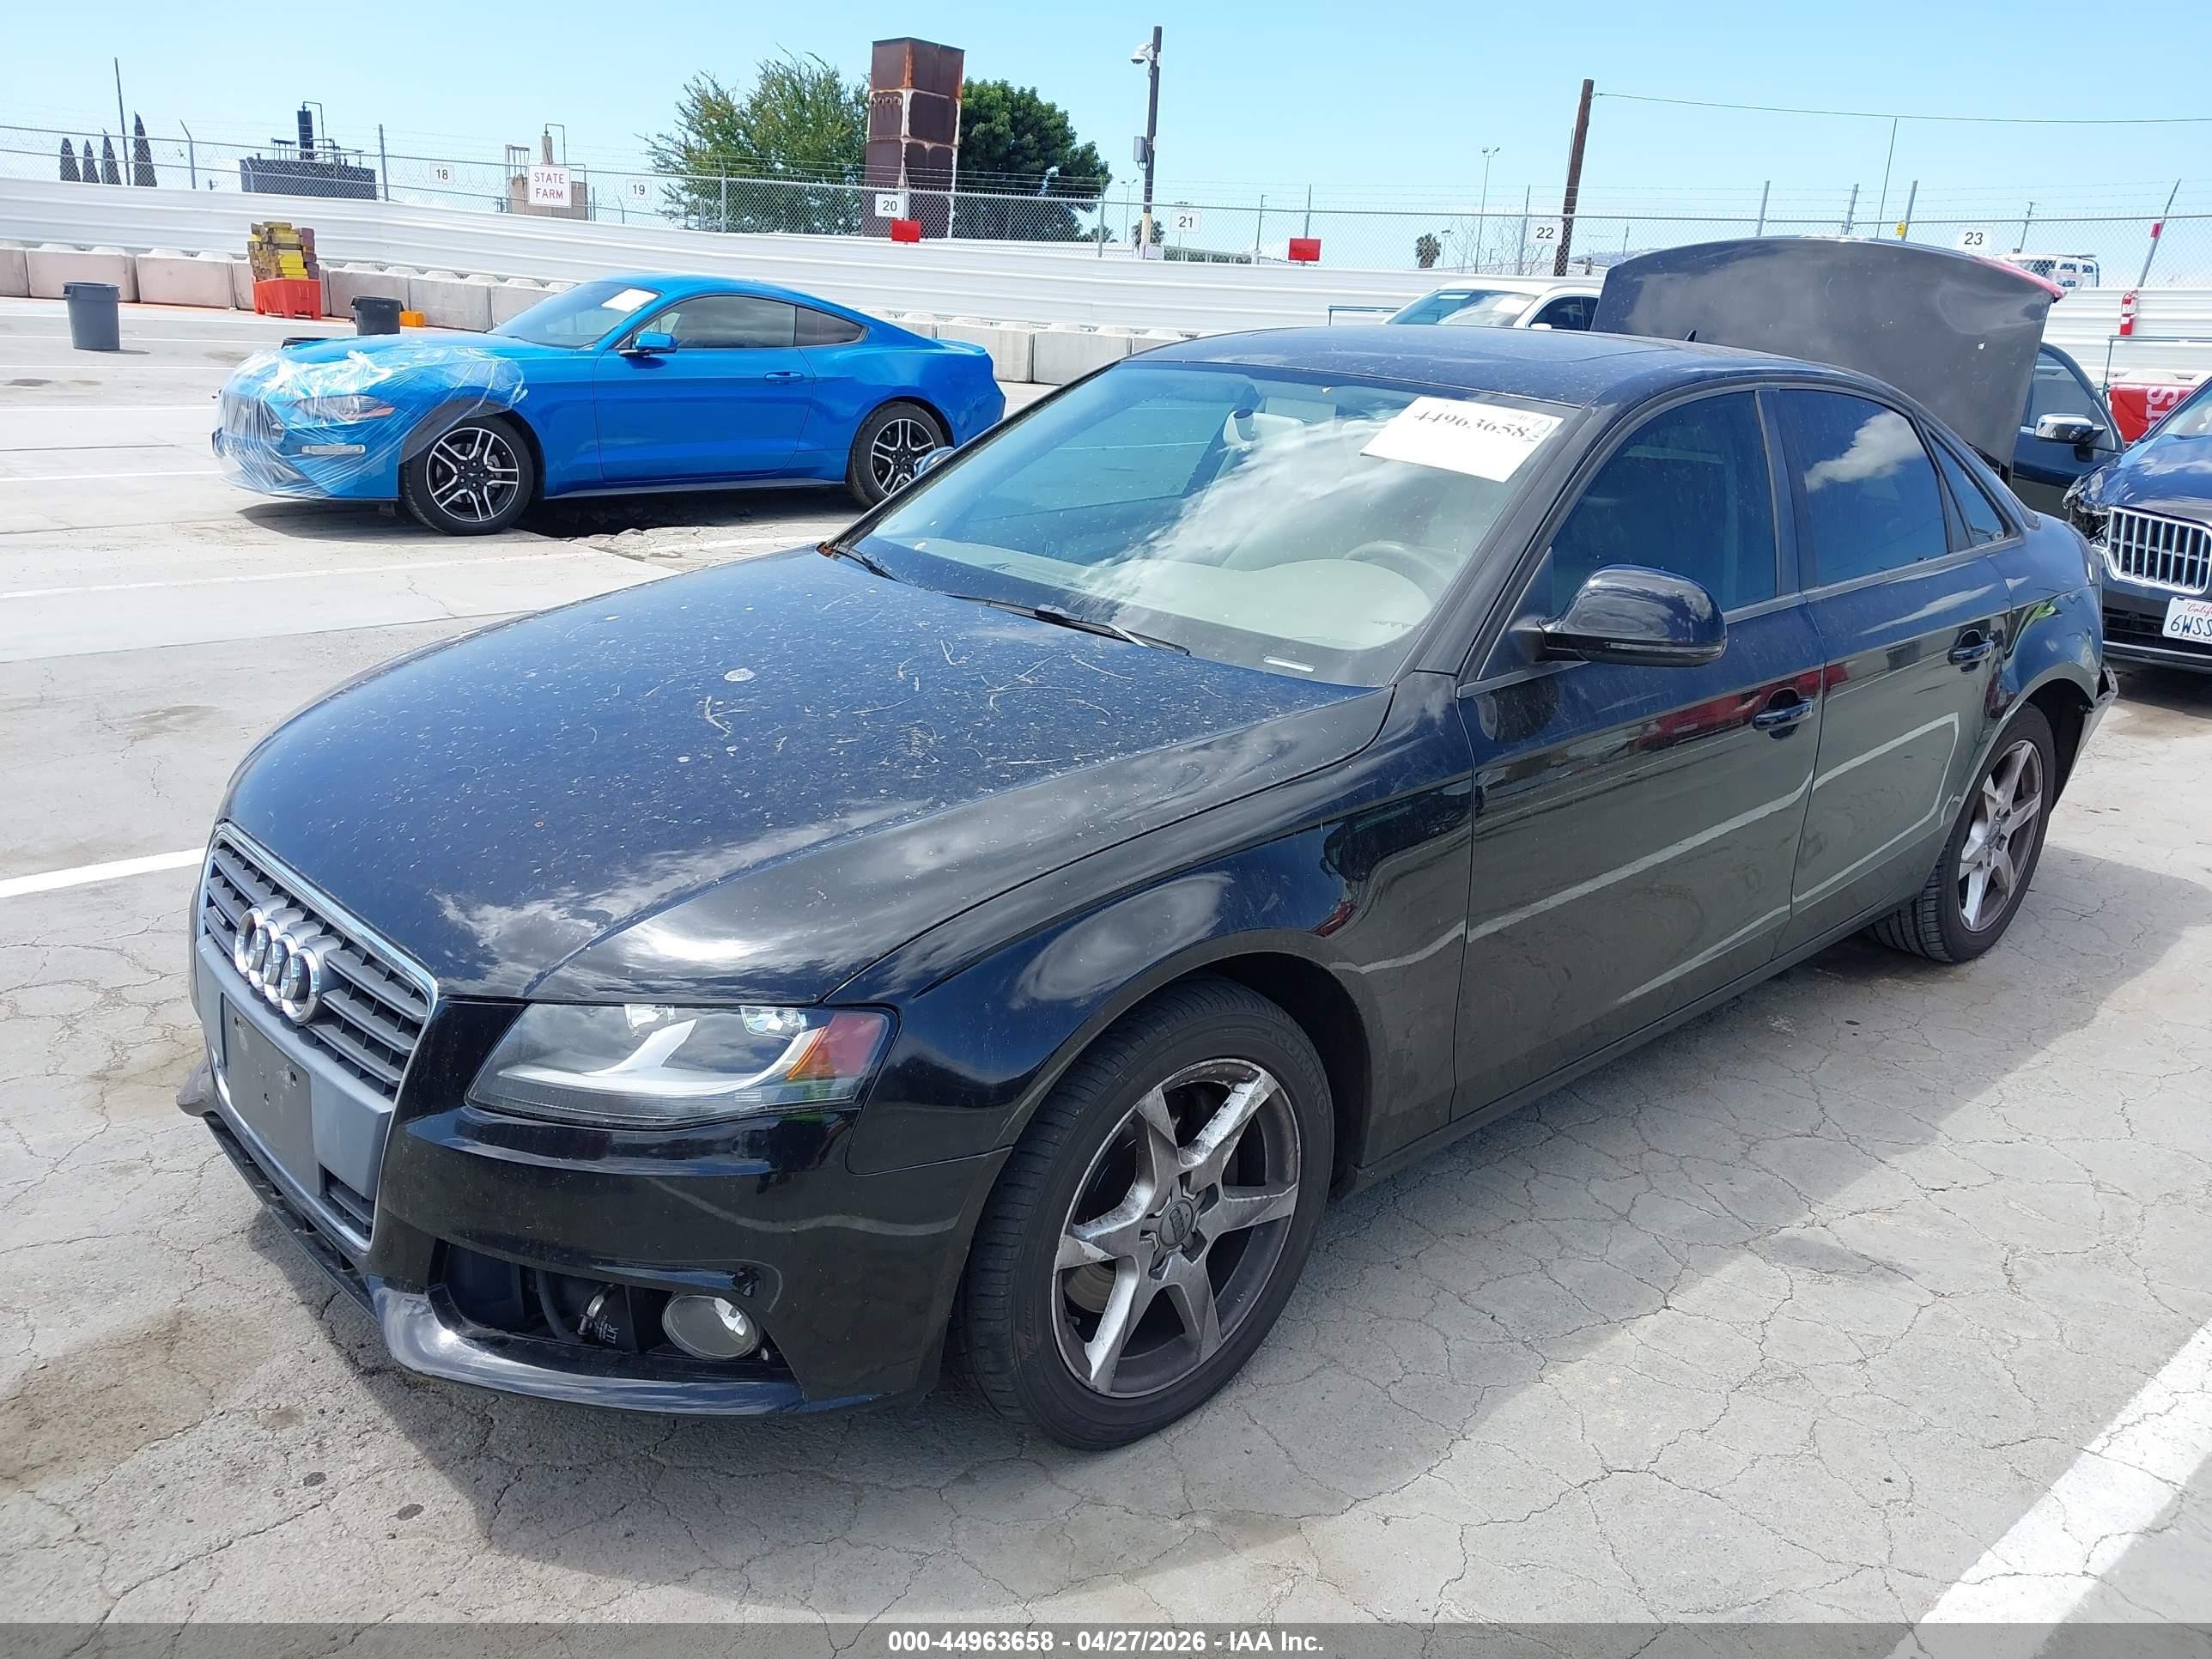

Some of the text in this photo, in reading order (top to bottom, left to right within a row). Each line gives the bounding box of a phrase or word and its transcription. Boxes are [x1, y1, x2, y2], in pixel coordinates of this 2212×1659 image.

[435, 168, 448, 180] 18
[534, 172, 564, 185] STATE
[535, 187, 564, 200] FARM
[632, 184, 646, 196] 19
[882, 199, 897, 212] 20
[1178, 216, 1194, 228] 21
[1535, 226, 1554, 240] 22
[1964, 231, 1984, 246] 23
